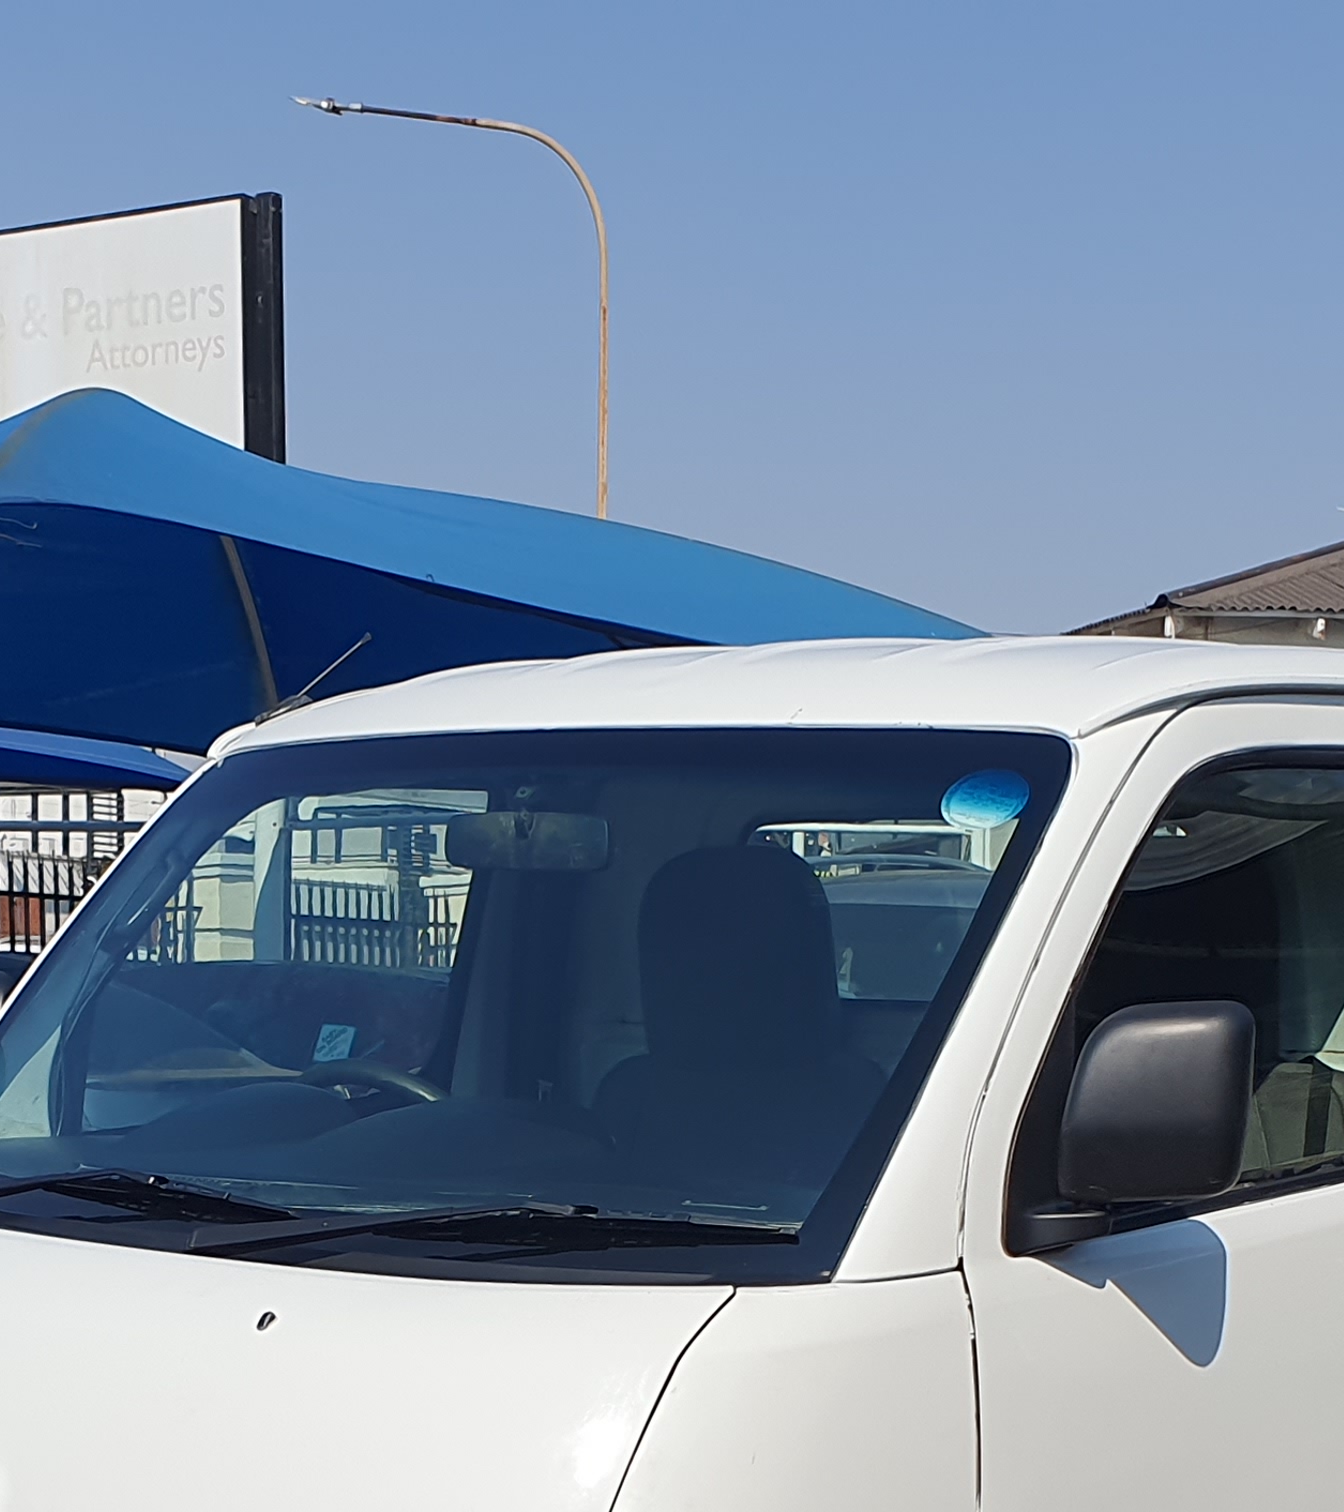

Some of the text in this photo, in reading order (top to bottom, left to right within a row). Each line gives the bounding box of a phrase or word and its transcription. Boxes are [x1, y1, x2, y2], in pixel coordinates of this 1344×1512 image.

[23, 297, 49, 340] &
[61, 283, 226, 334] Partners
[85, 332, 227, 374] Attorneys
